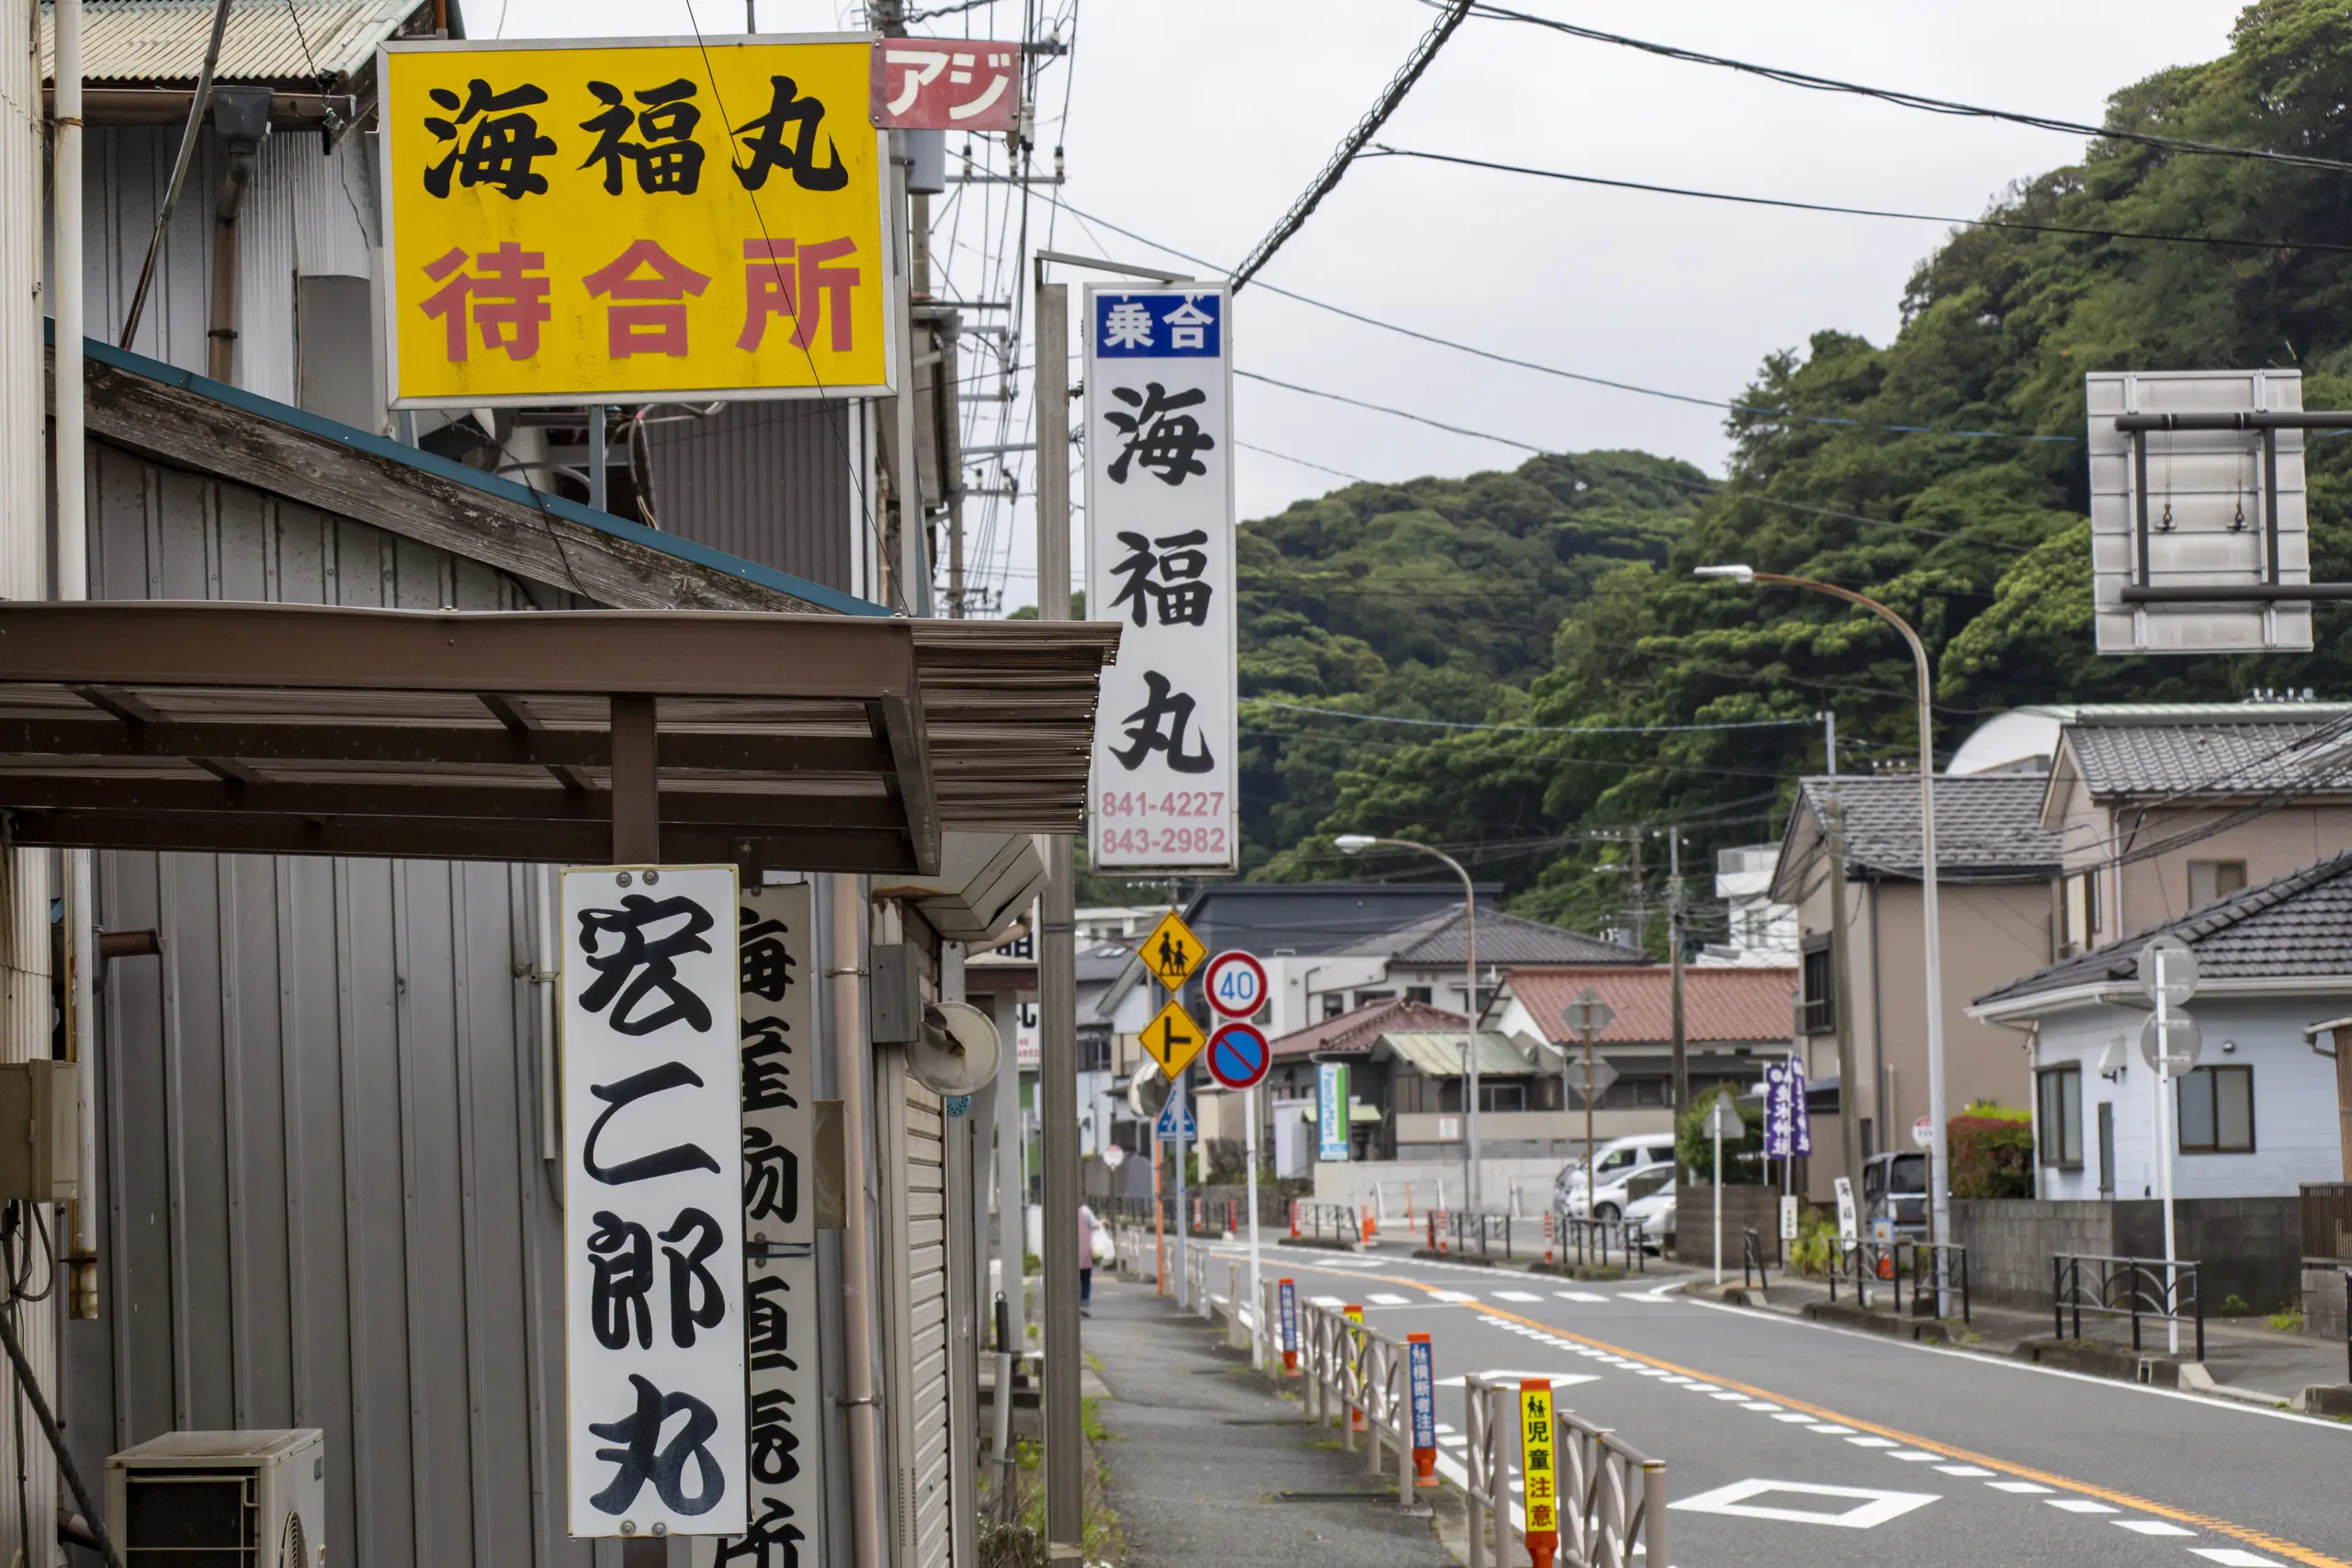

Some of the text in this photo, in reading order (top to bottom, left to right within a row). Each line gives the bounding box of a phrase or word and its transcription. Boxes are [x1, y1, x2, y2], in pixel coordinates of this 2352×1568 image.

[885, 51, 1011, 120] アジ
[424, 74, 848, 199] 海福丸
[420, 236, 861, 363] 待合所
[1103, 302, 1215, 349] 乗合
[1103, 382, 1215, 773] 海福丸
[1102, 792, 1225, 818] 841-4227
[1102, 828, 1225, 853] 843-2982
[1220, 971, 1254, 1000] 40
[578, 894, 726, 1517] 宏二郎丸
[1413, 1364, 1432, 1448] 横断者注意
[1528, 1421, 1553, 1527] 児童注意
